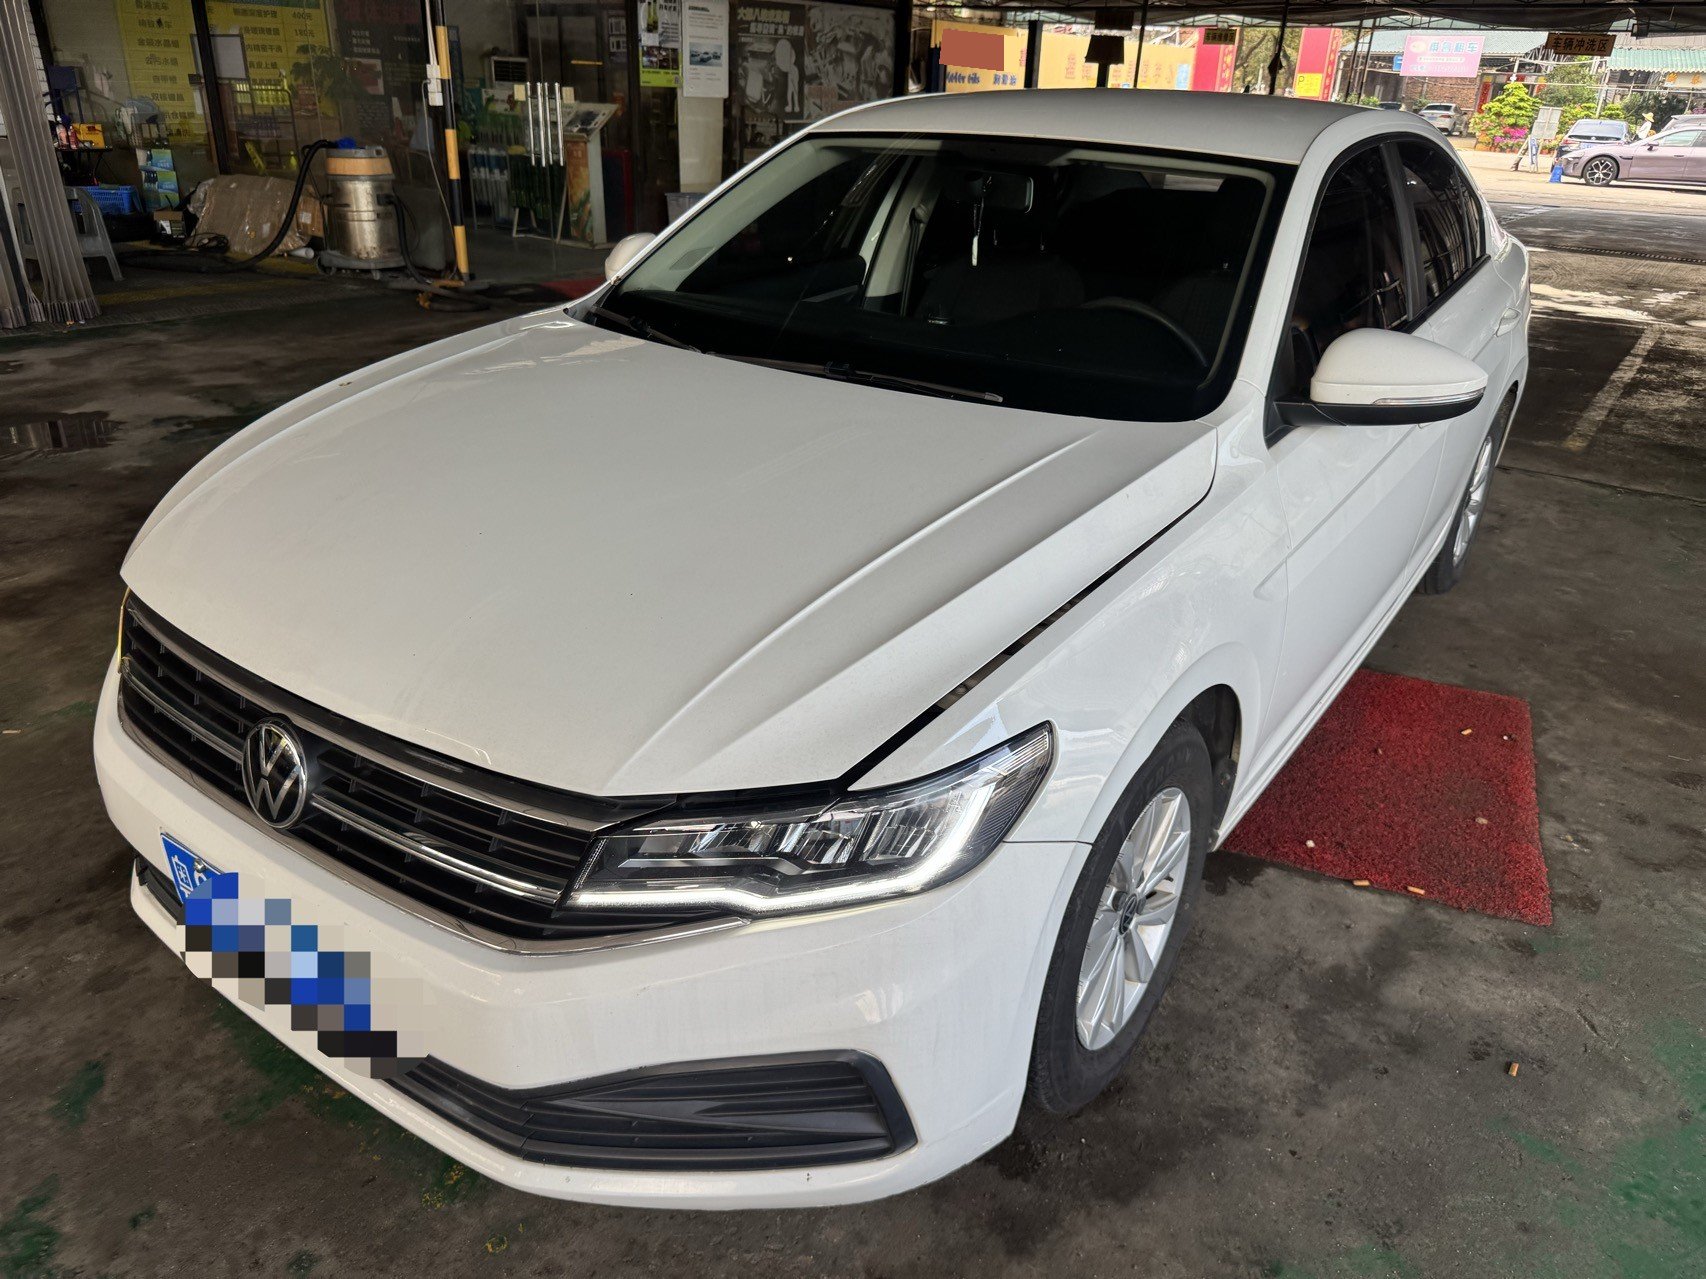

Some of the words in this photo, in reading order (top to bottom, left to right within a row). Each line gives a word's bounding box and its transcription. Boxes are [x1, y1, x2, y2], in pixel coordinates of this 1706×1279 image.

[1552, 36, 1609, 54] 车辆冲洗区
